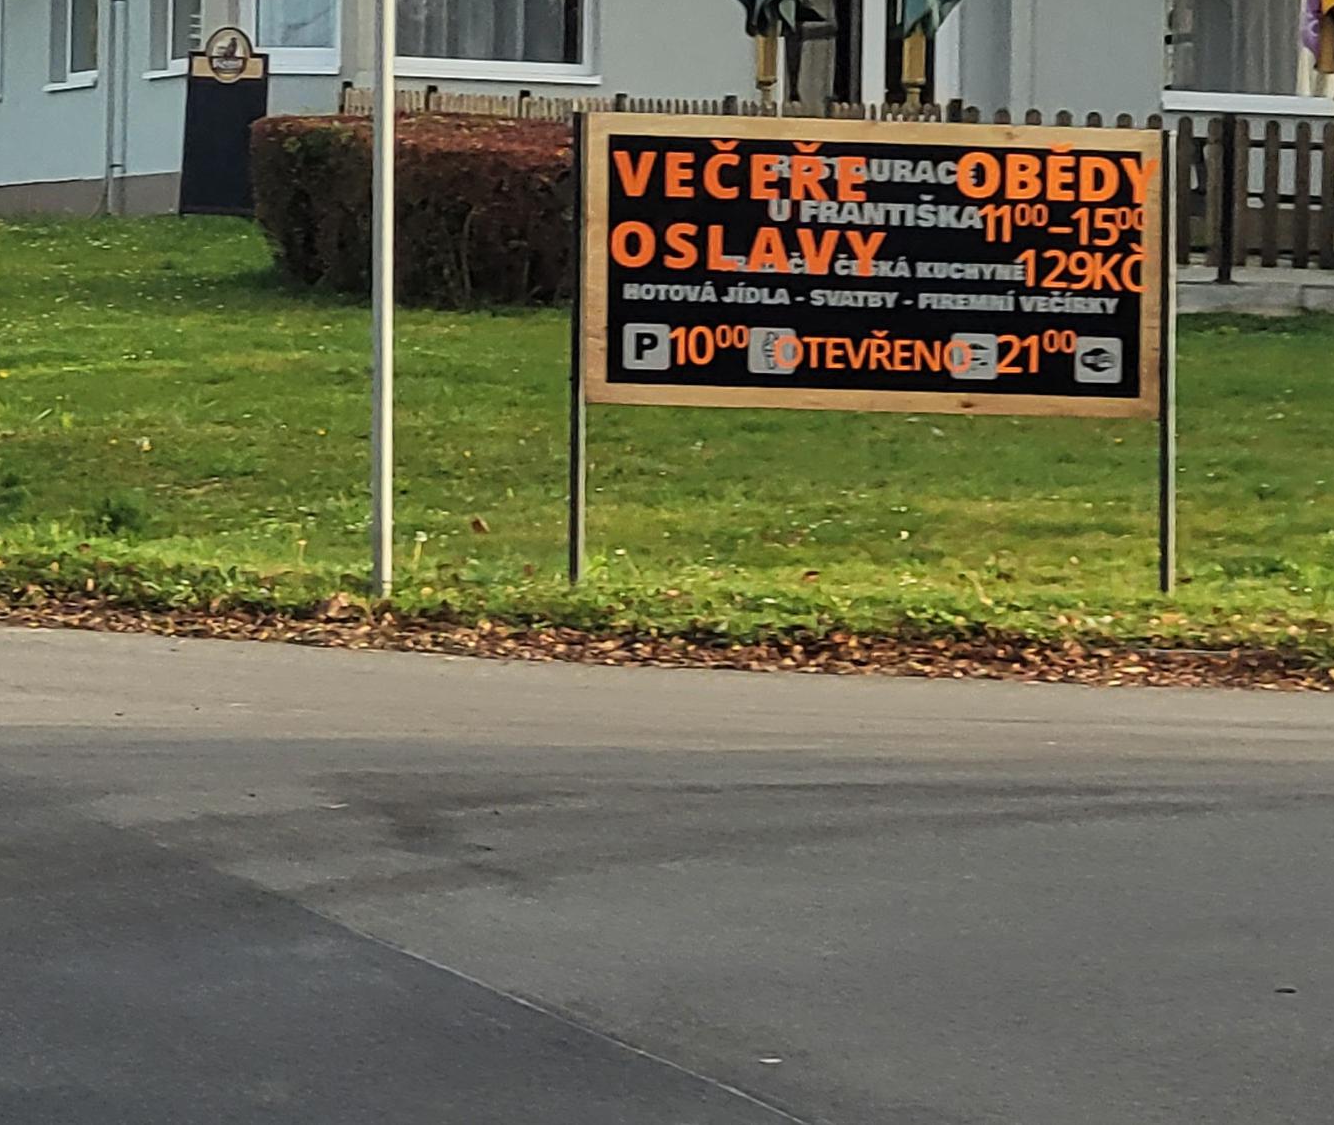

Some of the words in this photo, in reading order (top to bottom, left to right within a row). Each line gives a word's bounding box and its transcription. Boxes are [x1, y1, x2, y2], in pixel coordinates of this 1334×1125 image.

[612, 139, 867, 202] VEČEŘE
[955, 143, 1159, 204] OBĚDY
[768, 199, 793, 222] U
[799, 193, 984, 229] FRANTIŠKA
[610, 220, 887, 277] OSLAVY
[622, 280, 718, 303] HOTOVÁ
[720, 281, 791, 306] JÍDLA
[809, 288, 900, 308] SVATBY
[917, 290, 1016, 312] FIREMNÍ
[1018, 291, 1120, 315] VEČÍRKY
[634, 331, 659, 361] P
[773, 329, 972, 373] OTEVŘENO
